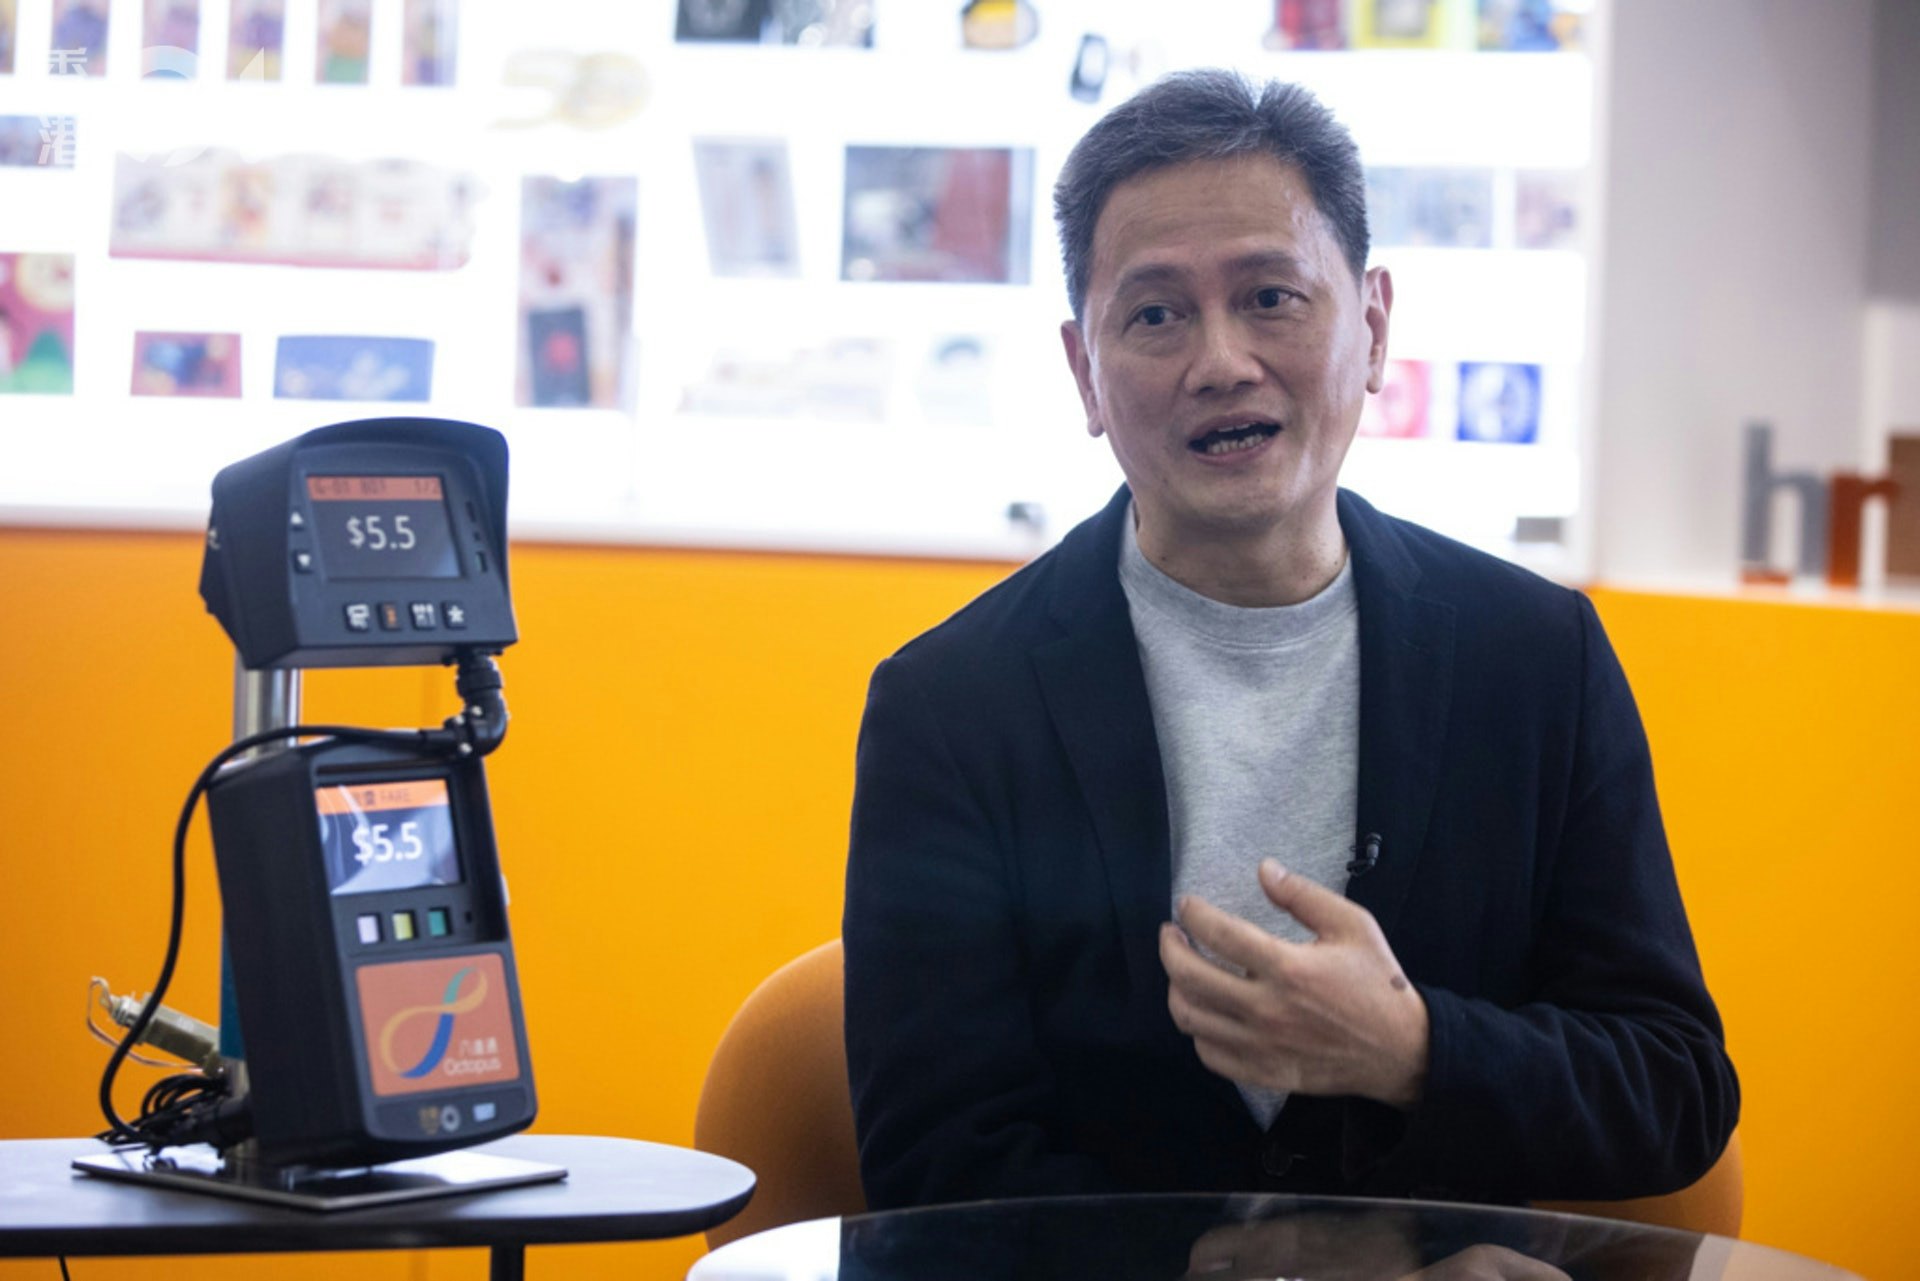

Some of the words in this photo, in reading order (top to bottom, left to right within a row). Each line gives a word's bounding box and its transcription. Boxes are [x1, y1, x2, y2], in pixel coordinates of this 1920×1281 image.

[346, 515, 415, 550] $5.5
[352, 823, 422, 865] $5.5
[443, 1056, 501, 1077] Octopus
